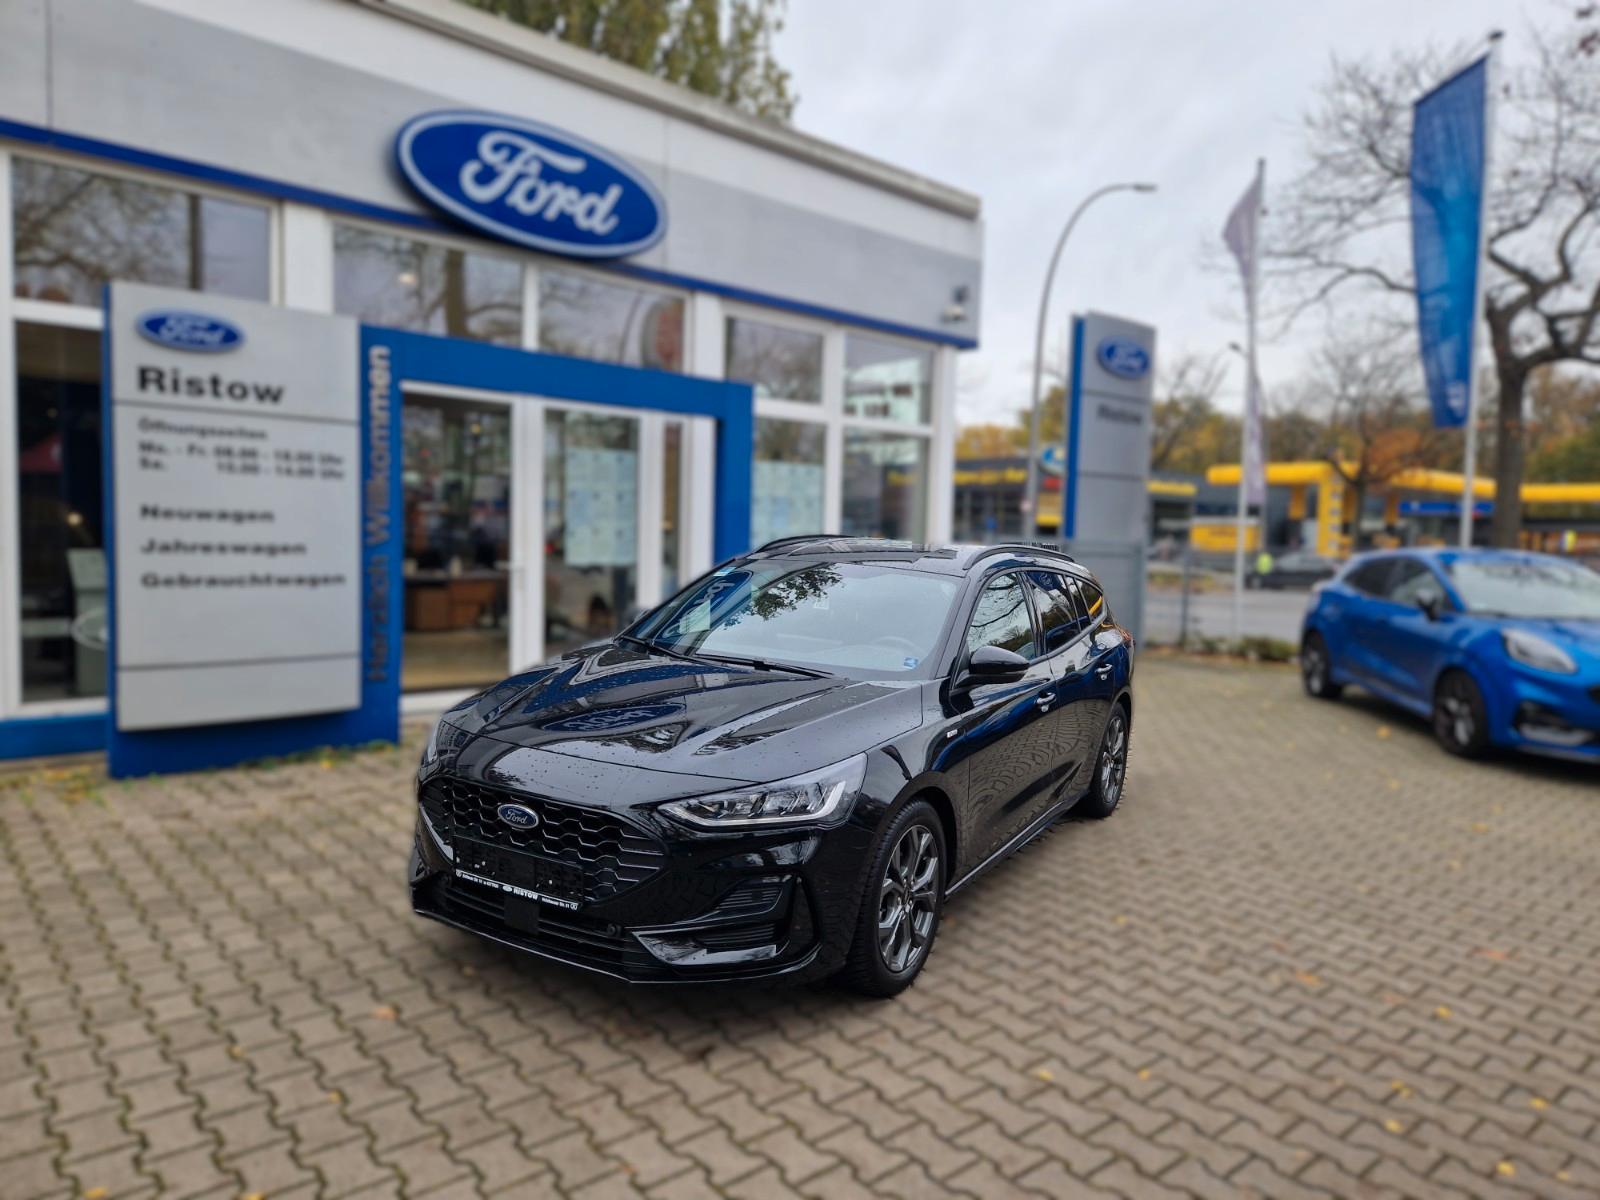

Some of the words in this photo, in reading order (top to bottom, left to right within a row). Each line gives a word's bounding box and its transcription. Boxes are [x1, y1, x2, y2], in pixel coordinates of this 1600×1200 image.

[458, 130, 623, 236] Ford
[136, 365, 285, 403] Ristow
[366, 345, 393, 546] Willkommen
[139, 504, 275, 524] Neuwagen
[140, 538, 307, 557] Jahreswagen
[140, 572, 347, 590] Gebrauchtwagen
[366, 555, 391, 683] Herzlich
